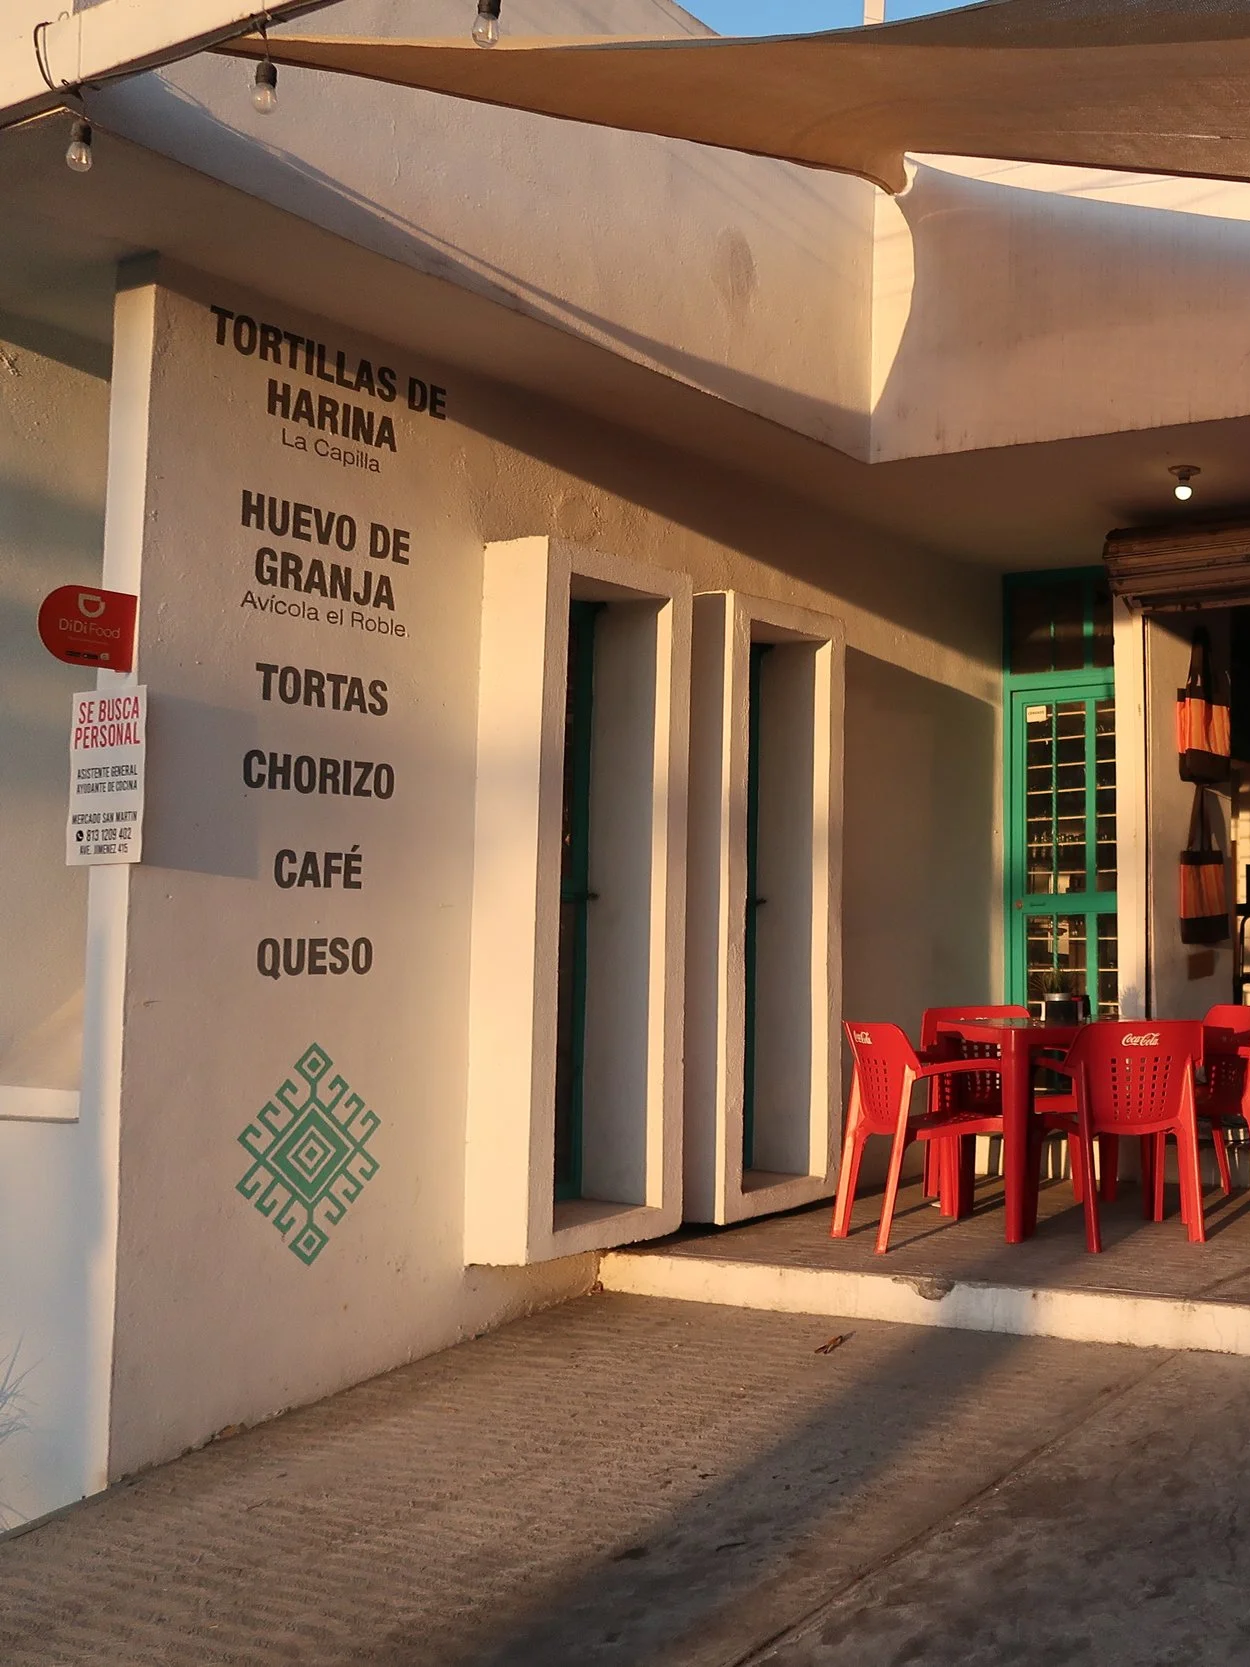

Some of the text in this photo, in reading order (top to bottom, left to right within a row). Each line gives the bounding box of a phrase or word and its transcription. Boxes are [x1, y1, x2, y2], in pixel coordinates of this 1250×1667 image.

[210, 304, 447, 420] TORTILLAS DE
[267, 378, 397, 453] HARINA
[282, 427, 381, 474] La Capilla
[241, 489, 411, 566] HUEVO DE
[254, 547, 395, 611] GRANJA
[240, 590, 406, 638] Avícola el Roble
[78, 696, 140, 725] SE BUSCA
[255, 661, 389, 717] TORTAS
[74, 721, 141, 750] PERSONAL
[76, 779, 138, 795] AYUDANTE DE COCINA
[77, 764, 138, 779] ASISTENTE GENERAL
[242, 749, 395, 800] CHORIZO
[102, 812, 114, 823] SAN
[273, 844, 363, 890] CAFÉ
[256, 936, 373, 981] QUESO
[1121, 1032, 1160, 1047] Coca-Cola
